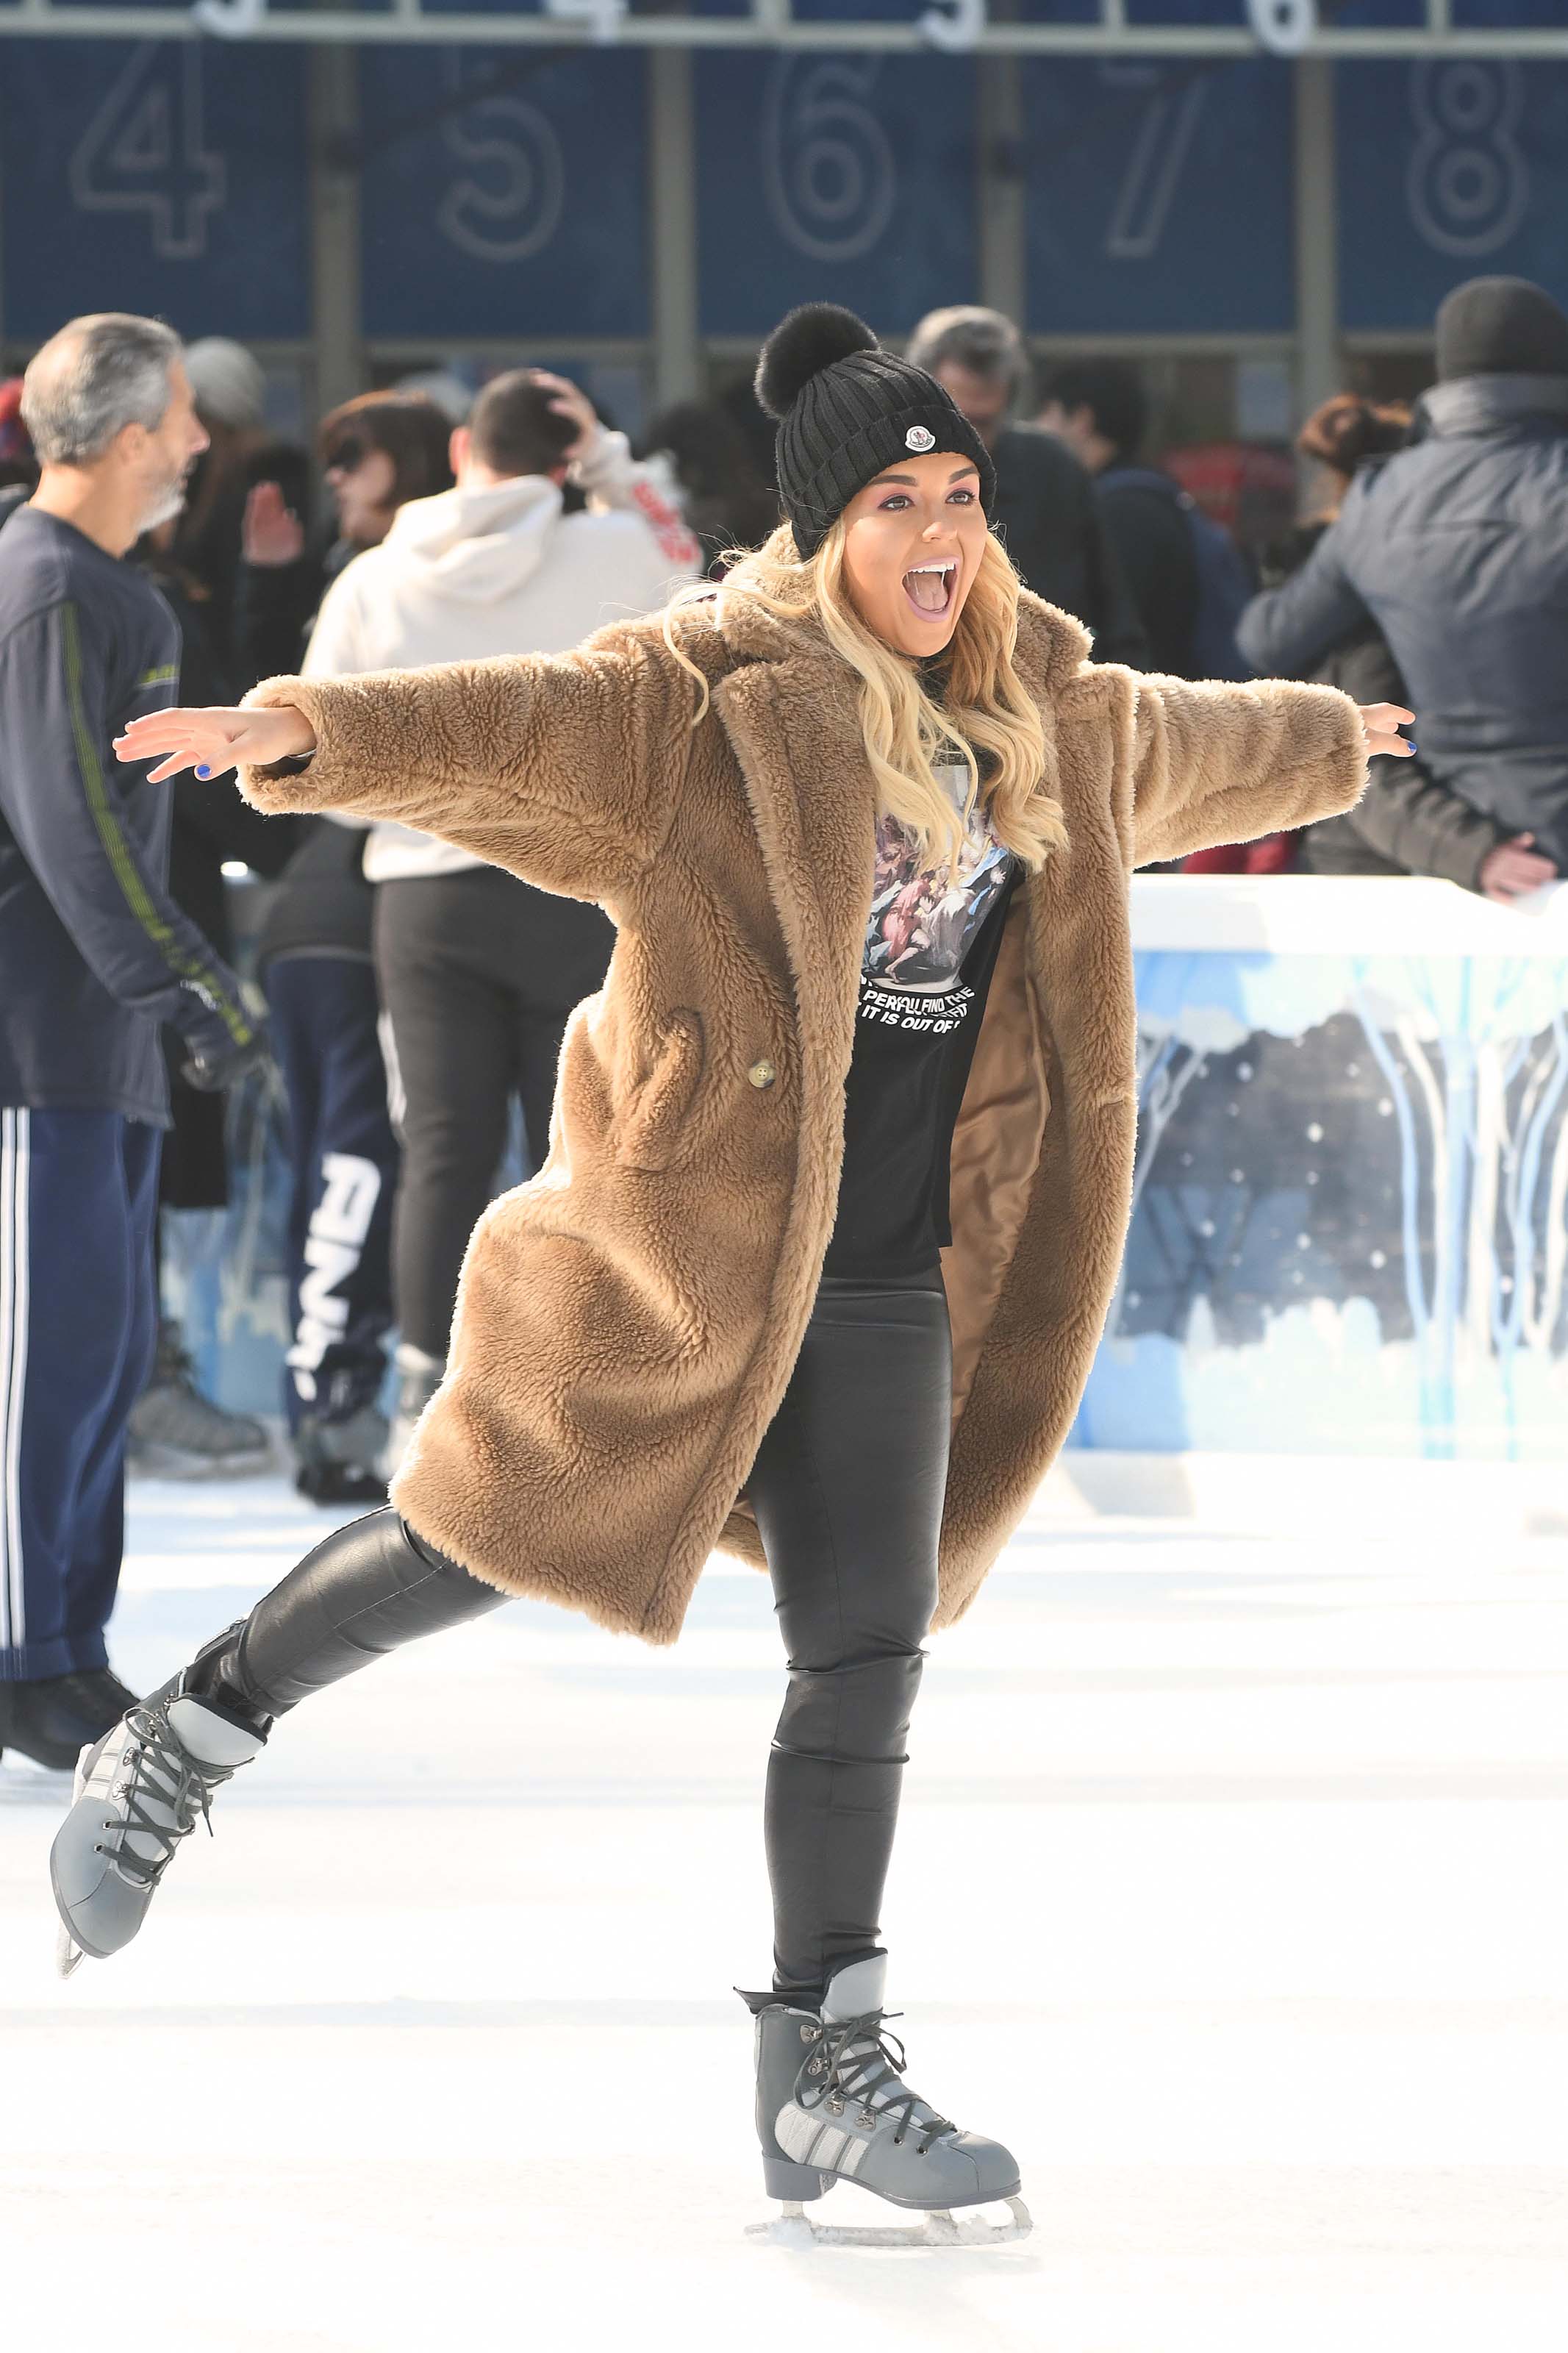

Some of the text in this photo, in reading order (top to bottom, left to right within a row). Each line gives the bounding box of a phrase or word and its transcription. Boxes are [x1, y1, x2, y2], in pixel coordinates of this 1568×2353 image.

[68, 38, 227, 260] 4
[439, 46, 565, 262] 5
[762, 51, 896, 261] 6
[1096, 57, 1209, 257] 7
[1406, 57, 1531, 257] 8
[862, 1004, 881, 1020] IT
[880, 1011, 901, 1025] IS
[901, 1017, 934, 1031] OUT
[933, 1019, 954, 1034] OF
[922, 998, 945, 1013] FIND
[945, 986, 975, 1006] THE
